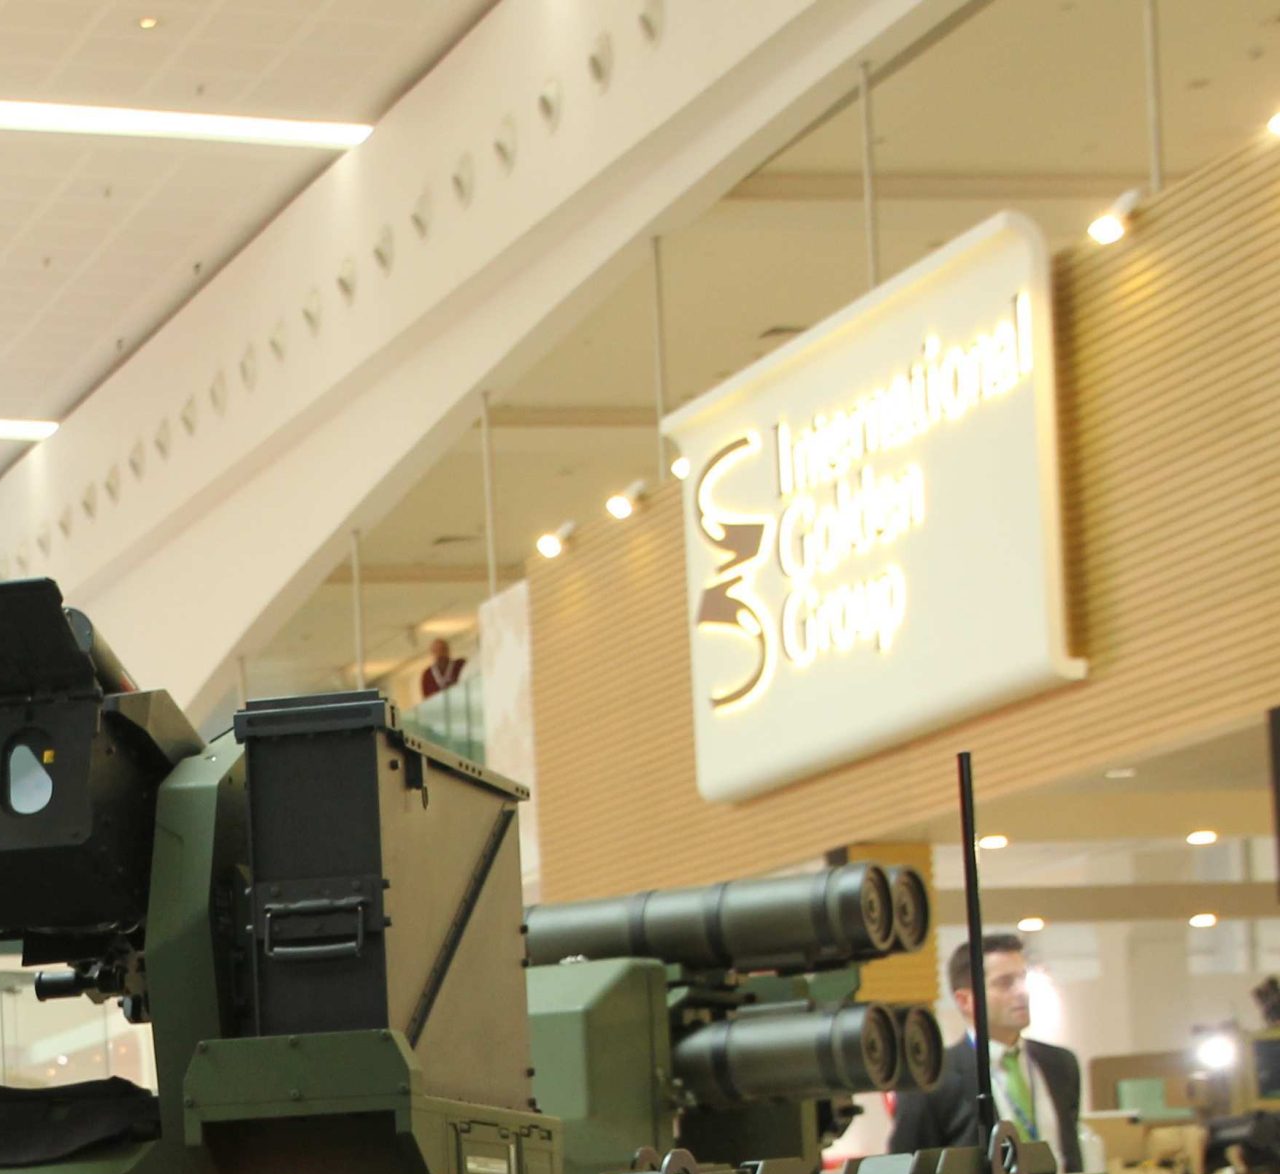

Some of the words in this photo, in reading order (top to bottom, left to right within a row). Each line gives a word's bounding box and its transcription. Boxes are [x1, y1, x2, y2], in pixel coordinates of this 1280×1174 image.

[775, 290, 1034, 500] International
[777, 462, 926, 583] Golden
[781, 562, 908, 668] Group
